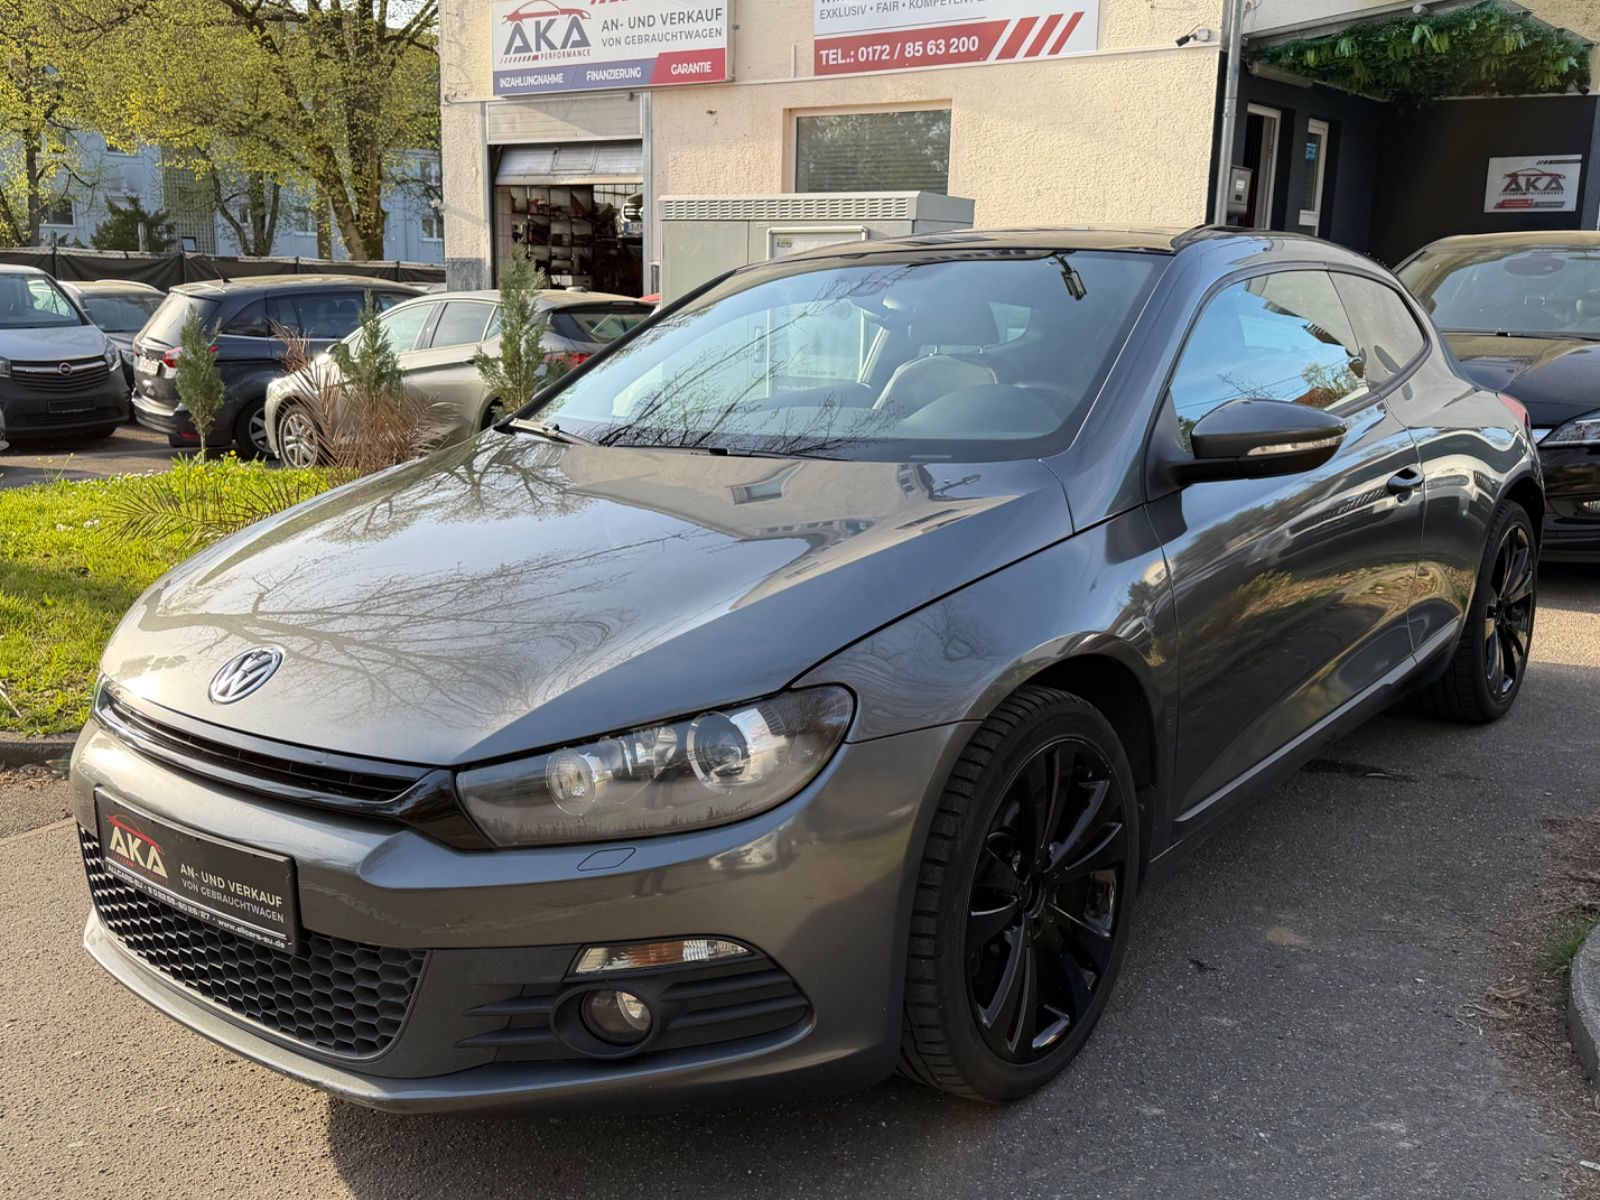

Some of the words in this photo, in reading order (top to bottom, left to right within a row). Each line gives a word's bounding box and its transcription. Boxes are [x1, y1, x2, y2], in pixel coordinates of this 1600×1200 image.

[601, 19, 624, 32] AN-
[628, 14, 656, 29] UND
[660, 8, 723, 26] VERKAUF
[819, 4, 867, 20] EXKLUSIV
[876, 2, 899, 14] FAIR
[503, 15, 591, 55] AKA
[601, 37, 621, 47] VON
[624, 27, 722, 45] GEBRAUCHTWAGEN
[540, 48, 591, 61] PERFORMANCE
[819, 48, 854, 65] TEL.:
[858, 44, 890, 62] 0172
[904, 41, 923, 57] 85
[927, 39, 946, 55] 63
[949, 36, 979, 53] 200
[586, 67, 642, 82] FINANZIERUNG
[670, 61, 712, 75] GARANTIE
[1502, 176, 1564, 192] AKA
[110, 826, 168, 878] AKA
[180, 863, 199, 878] AN-
[201, 871, 225, 888] UND
[228, 880, 282, 907] VERKAUF
[182, 878, 199, 893] VON
[200, 885, 284, 923] GEBRAUCHTWAGEN
